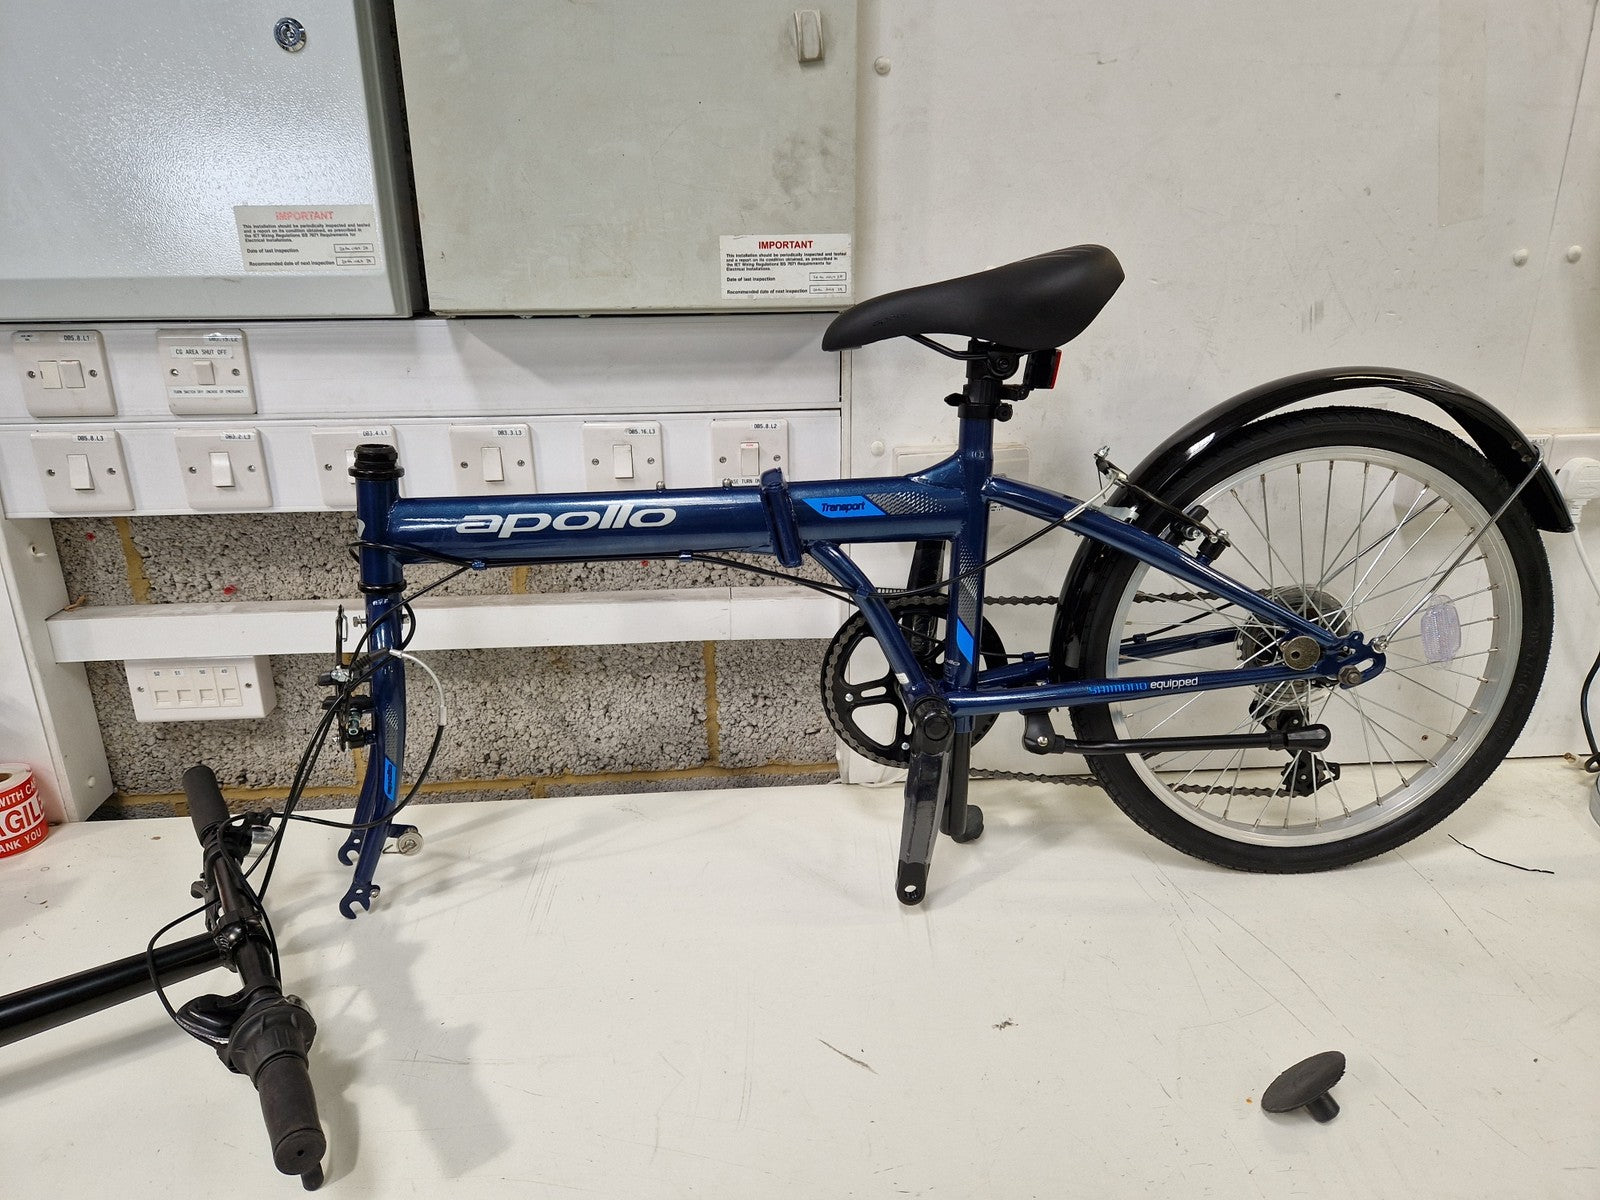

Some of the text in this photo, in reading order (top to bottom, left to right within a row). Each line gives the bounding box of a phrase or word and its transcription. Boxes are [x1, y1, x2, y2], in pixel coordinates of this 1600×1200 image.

[275, 211, 334, 221] IMPORTANT
[758, 240, 814, 250] IMPORTANT
[821, 501, 866, 513] Transport
[455, 504, 677, 539] apollo
[1087, 677, 1199, 696] SHIMANO equipped
[24, 828, 42, 844] YOU
